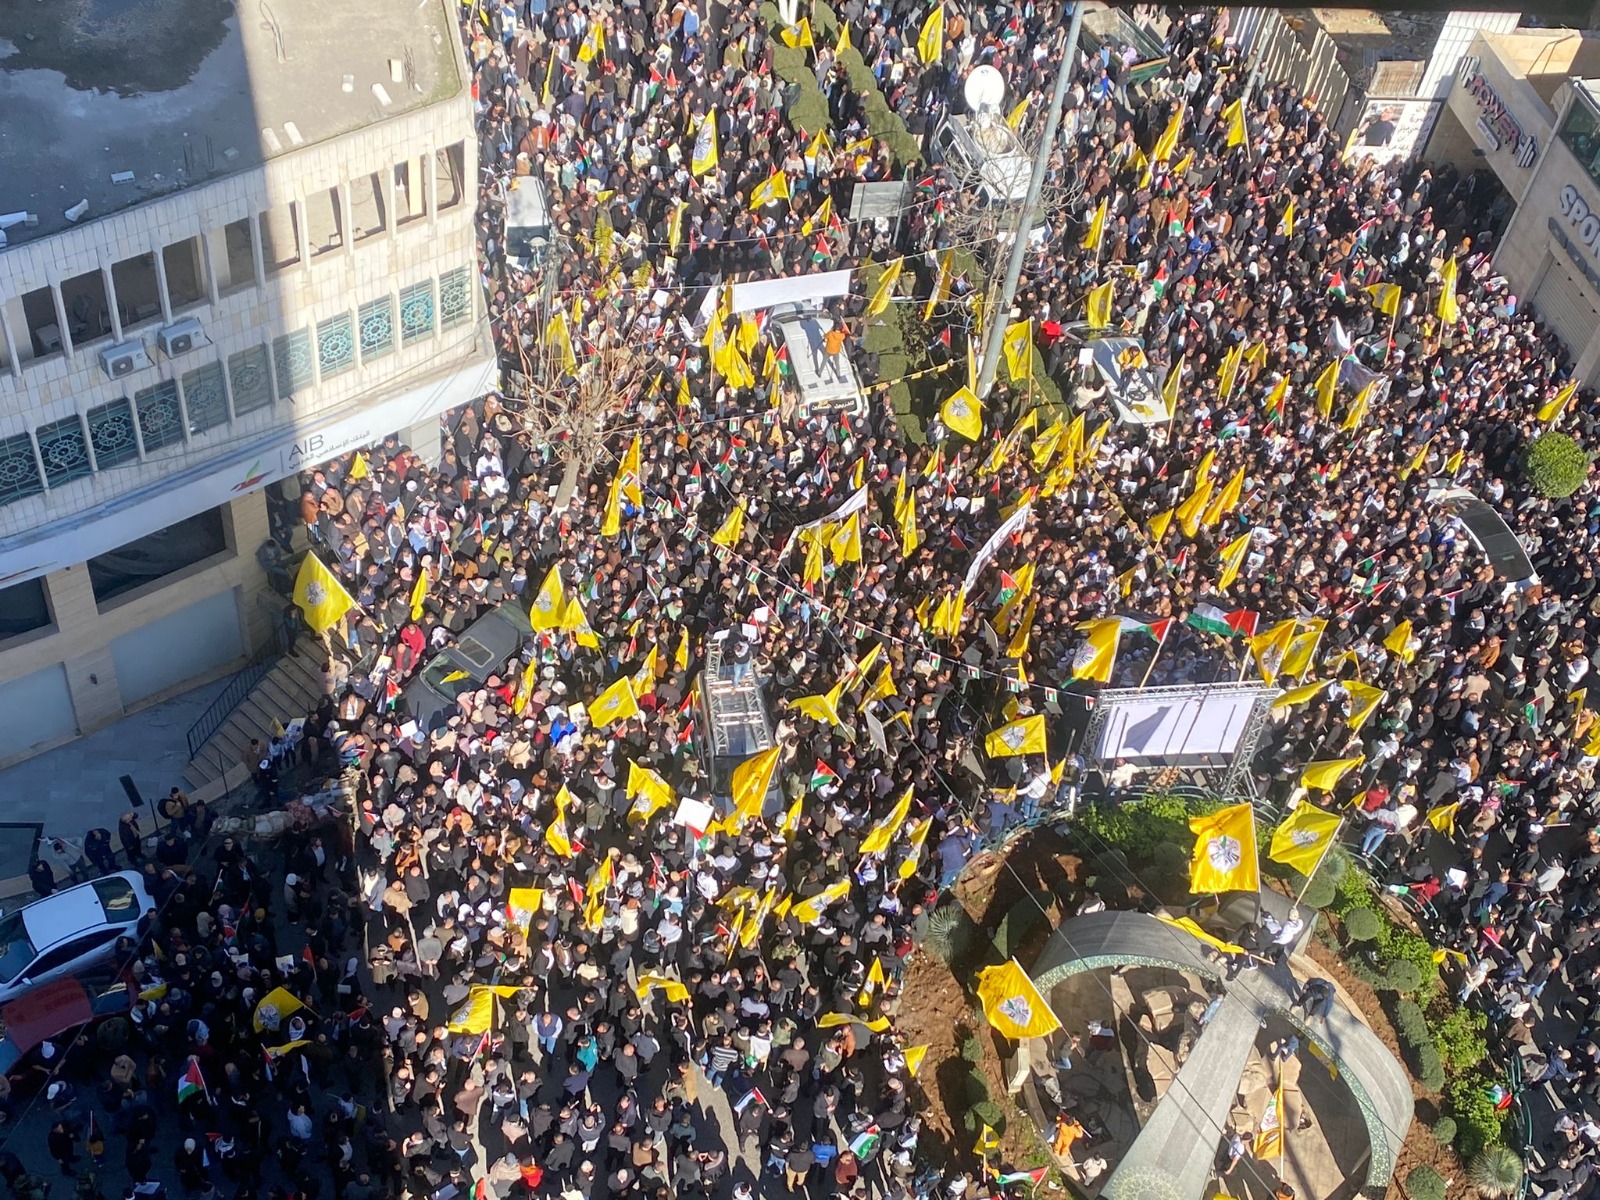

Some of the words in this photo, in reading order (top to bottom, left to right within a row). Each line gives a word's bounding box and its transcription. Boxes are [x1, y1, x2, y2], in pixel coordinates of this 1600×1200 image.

[1470, 75, 1520, 152] POWER
[351, 430, 370, 442] البنك
[288, 434, 324, 461] AIB
[288, 453, 314, 469] العربي
